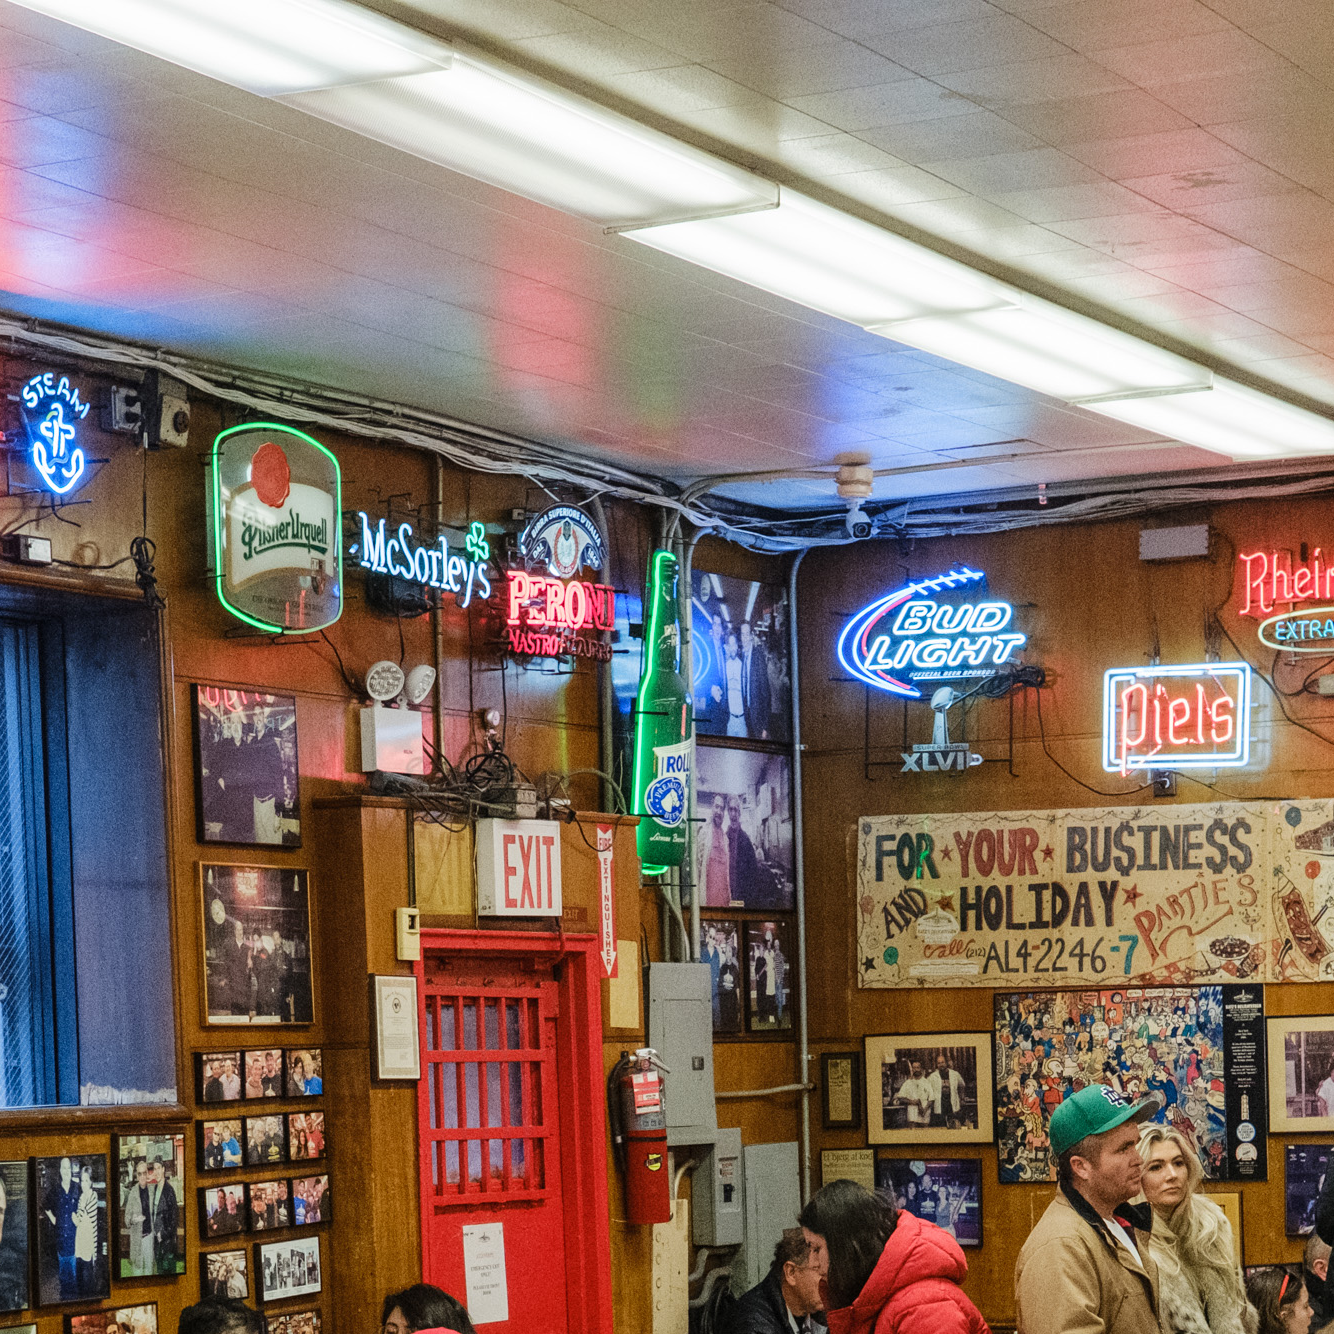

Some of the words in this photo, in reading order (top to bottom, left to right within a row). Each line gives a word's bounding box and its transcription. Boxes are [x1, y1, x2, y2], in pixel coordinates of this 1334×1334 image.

[22, 372, 91, 420] STEAM
[289, 507, 327, 554] Urquell
[531, 516, 549, 539] BIRRA
[548, 507, 582, 520] SUPERIORE
[580, 512, 602, 547] D'ITALIA
[359, 511, 491, 609] McSorley's
[506, 570, 616, 632] PERONI
[891, 599, 1013, 636] BUD
[507, 628, 559, 656] NASTRO
[864, 632, 1027, 671] LIGHT
[1121, 683, 1235, 776] Piels
[598, 837, 612, 852] FIRE
[874, 825, 940, 882] FOR
[952, 828, 1039, 878] YOUR
[1065, 816, 1254, 877] BU$INE$$
[502, 833, 556, 910] EXIT
[563, 908, 579, 921] EXIT
[603, 857, 612, 967] EXTINGUISHER
[882, 884, 929, 941] AND
[959, 880, 1120, 933] HOLIDAY
[1134, 872, 1260, 965] PARTIES
[965, 945, 987, 960] (212)
